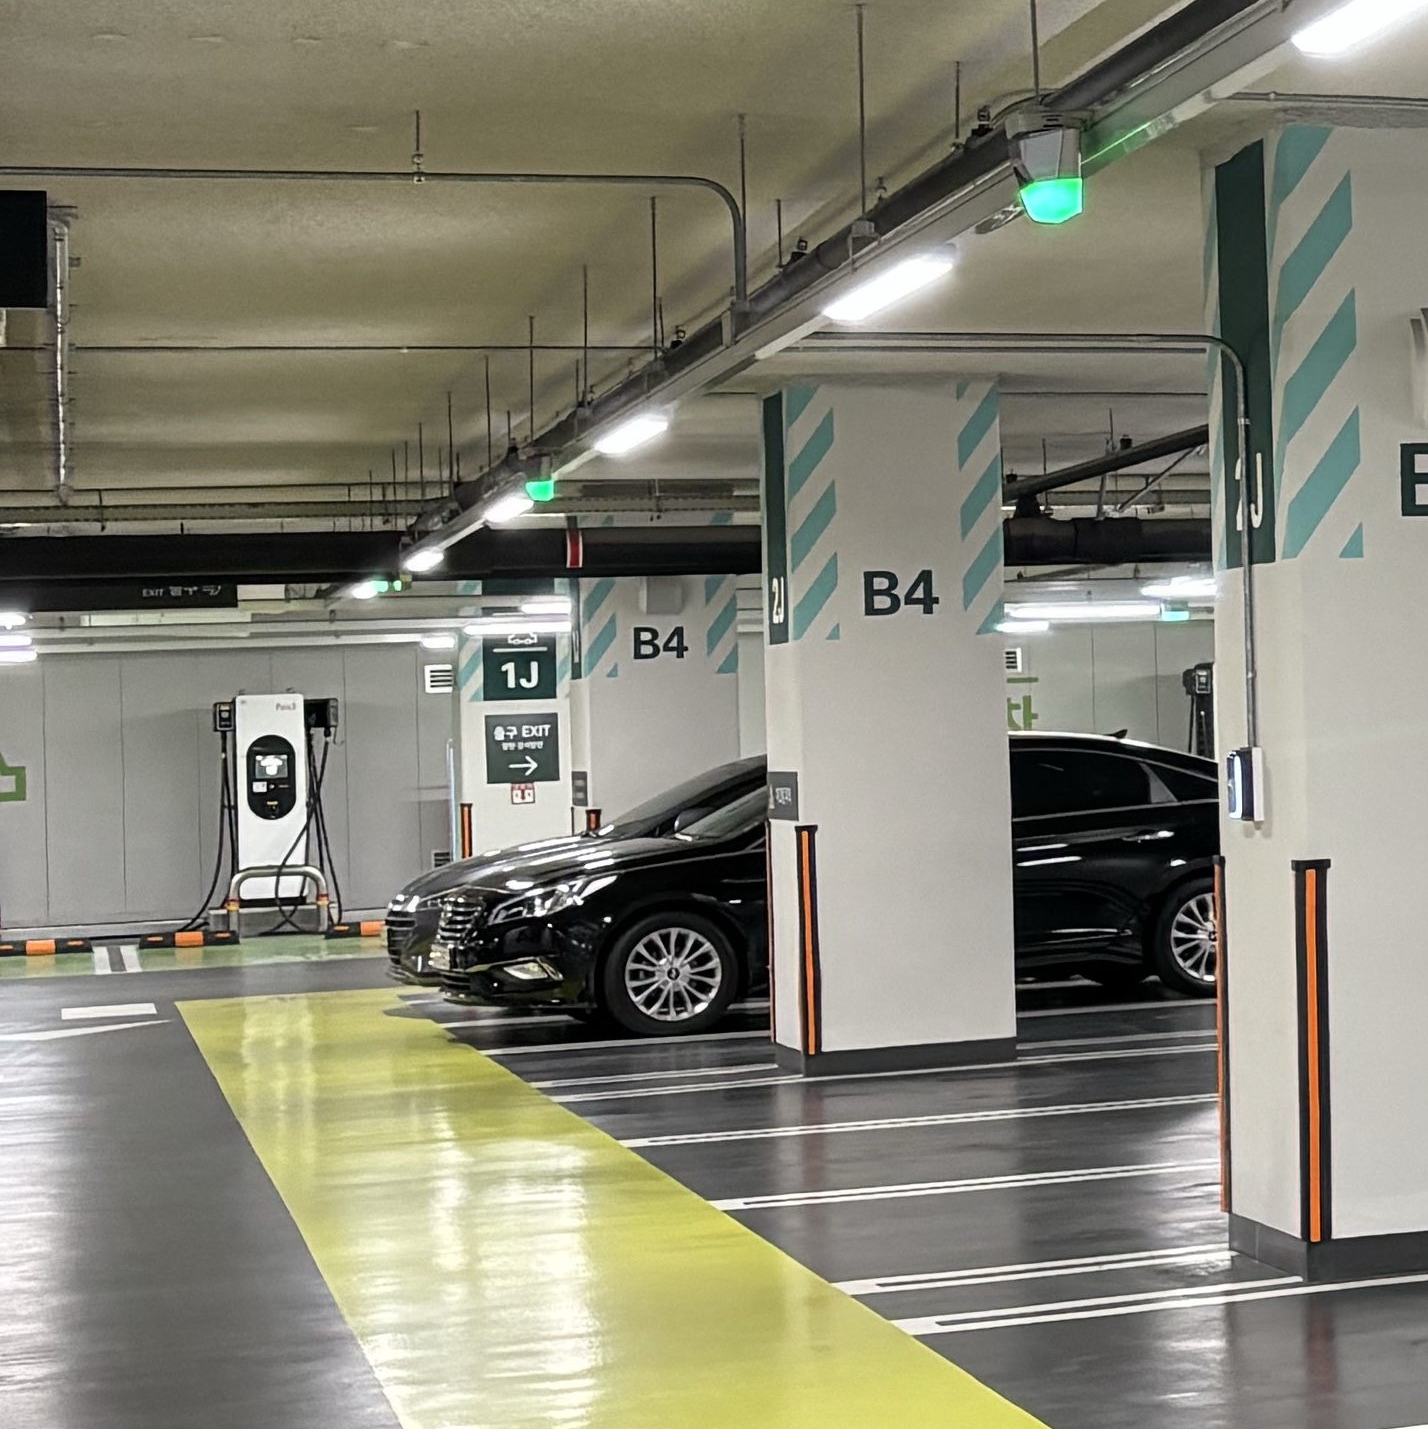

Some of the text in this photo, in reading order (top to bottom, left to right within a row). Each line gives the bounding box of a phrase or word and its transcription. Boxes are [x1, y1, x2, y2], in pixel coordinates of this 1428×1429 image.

[863, 569, 940, 617] B4
[633, 625, 690, 660] B4
[501, 661, 539, 689] 1J
[522, 724, 551, 738] EXIT
